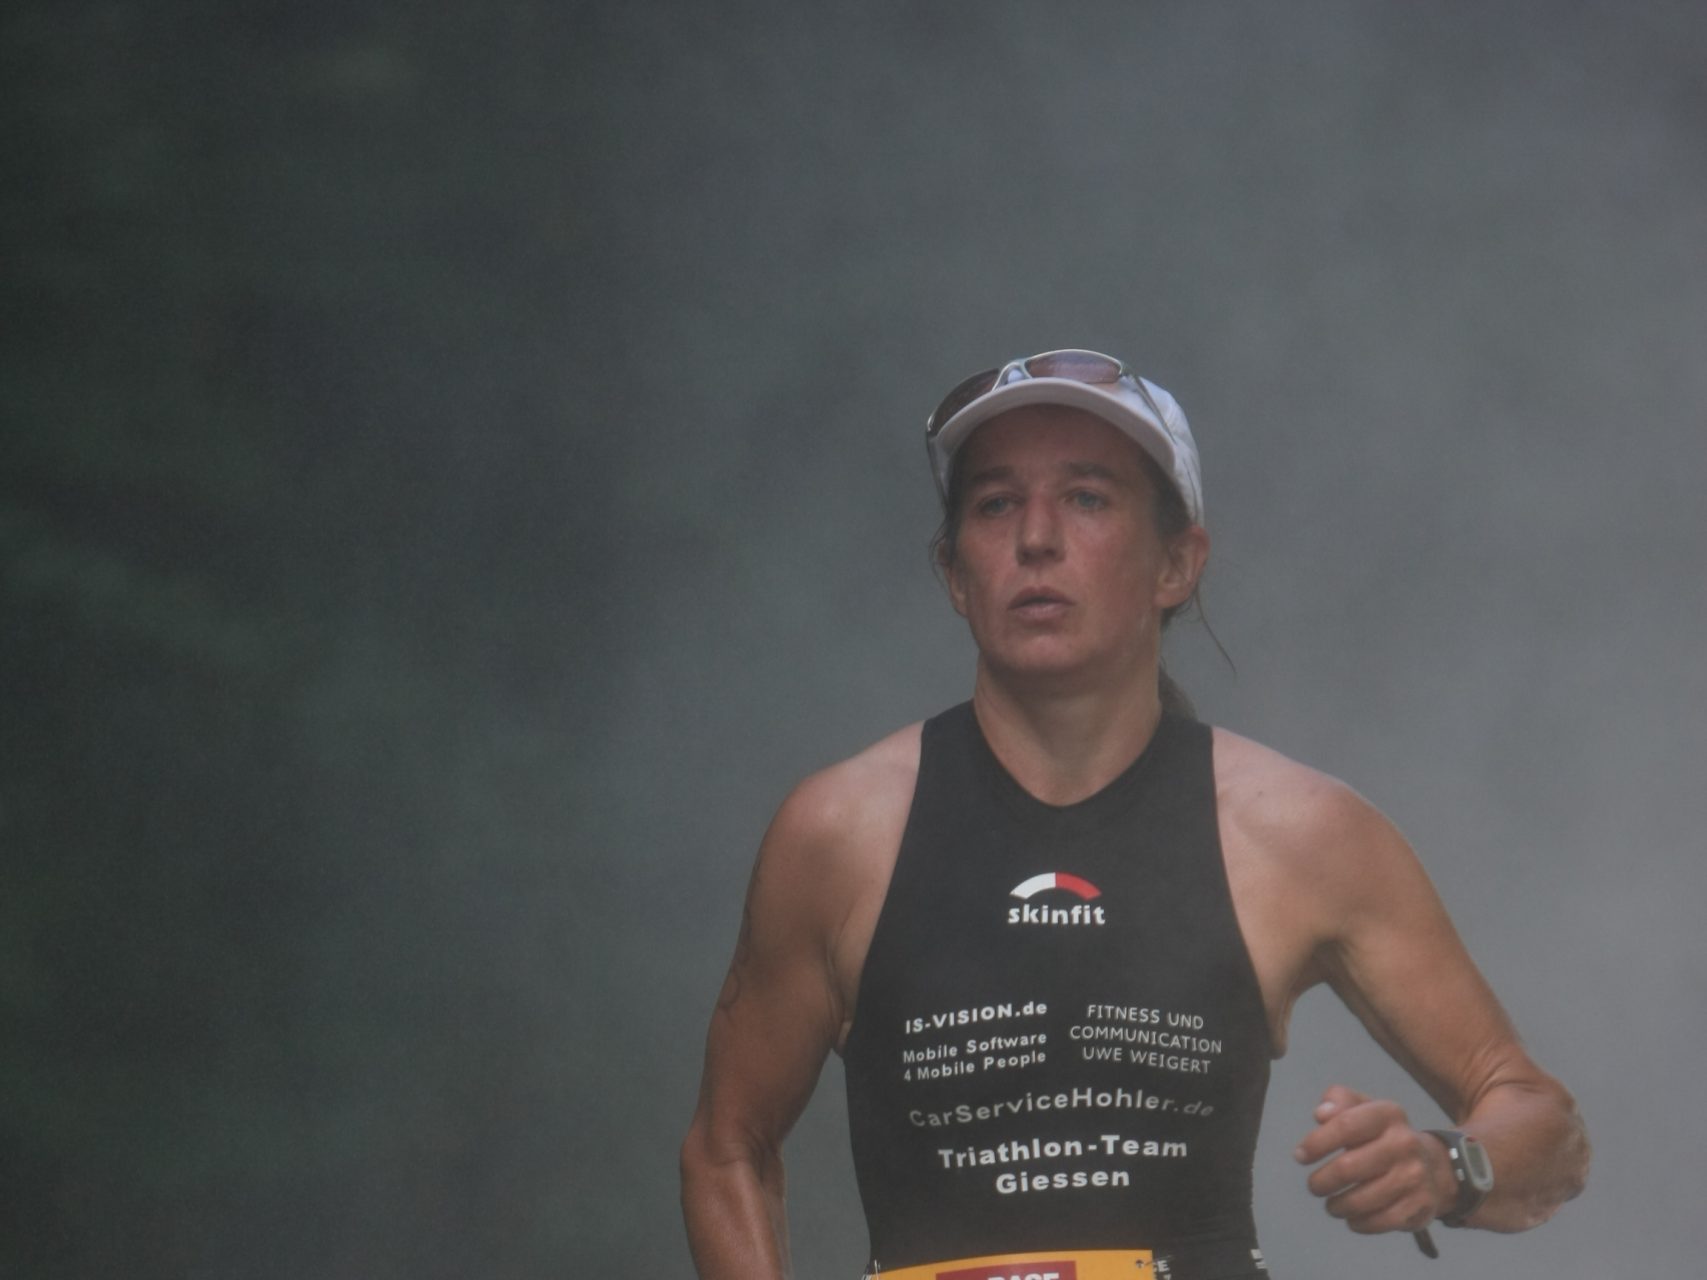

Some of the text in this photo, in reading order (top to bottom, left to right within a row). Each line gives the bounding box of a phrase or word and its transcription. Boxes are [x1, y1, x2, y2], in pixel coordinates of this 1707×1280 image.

[1008, 904, 1106, 925] skinfit
[905, 1001, 1047, 1034] IS-VISION.de
[1087, 1004, 1204, 1029] FITNESS UND
[903, 1033, 1047, 1063] Mobile Software
[1070, 1026, 1222, 1053] COMMUNICATION
[904, 1050, 1046, 1081] 4 Mobile People
[1082, 1047, 1211, 1073] UWE WEIGERT
[909, 1087, 1215, 1128] CarServiceHohler.de
[938, 1134, 1188, 1169] Triathlon-Team
[996, 1170, 1130, 1194] Giessen
